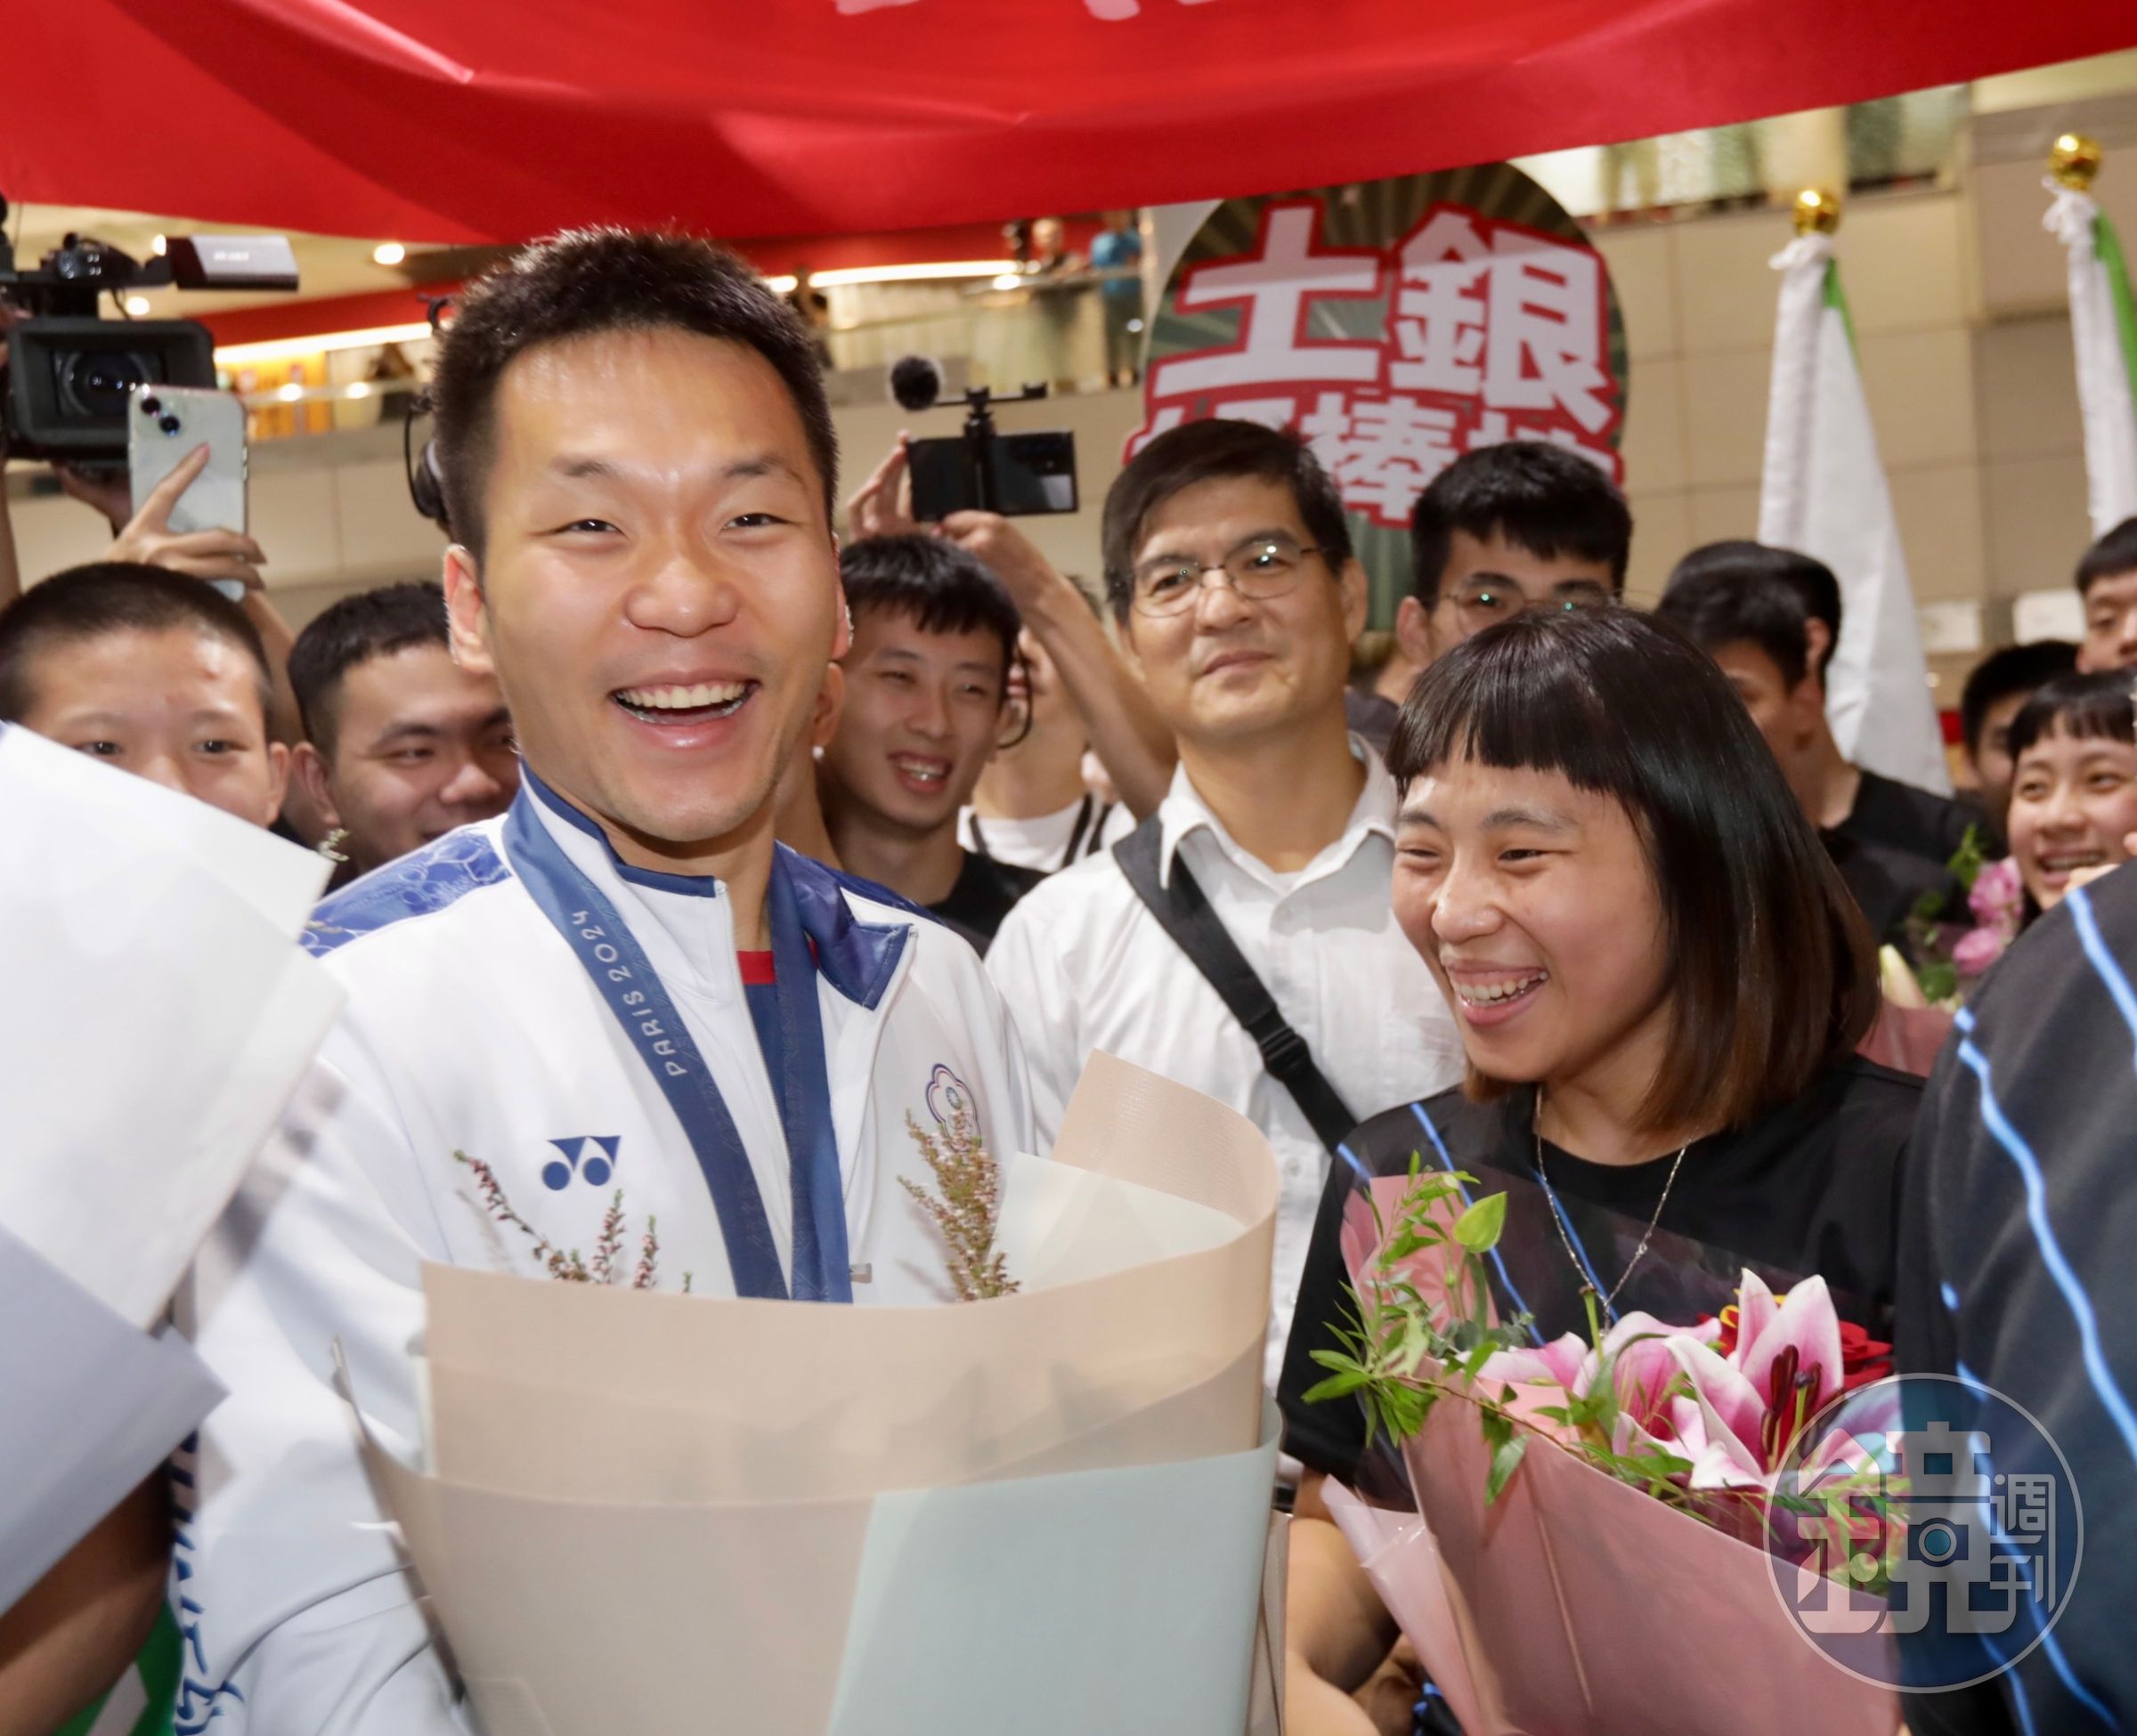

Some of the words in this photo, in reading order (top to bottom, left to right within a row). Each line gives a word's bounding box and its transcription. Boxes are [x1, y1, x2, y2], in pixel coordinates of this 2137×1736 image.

[1152, 204, 1613, 435] 土銀
[572, 910, 633, 983] 2024
[623, 990, 688, 1076] PARIS
